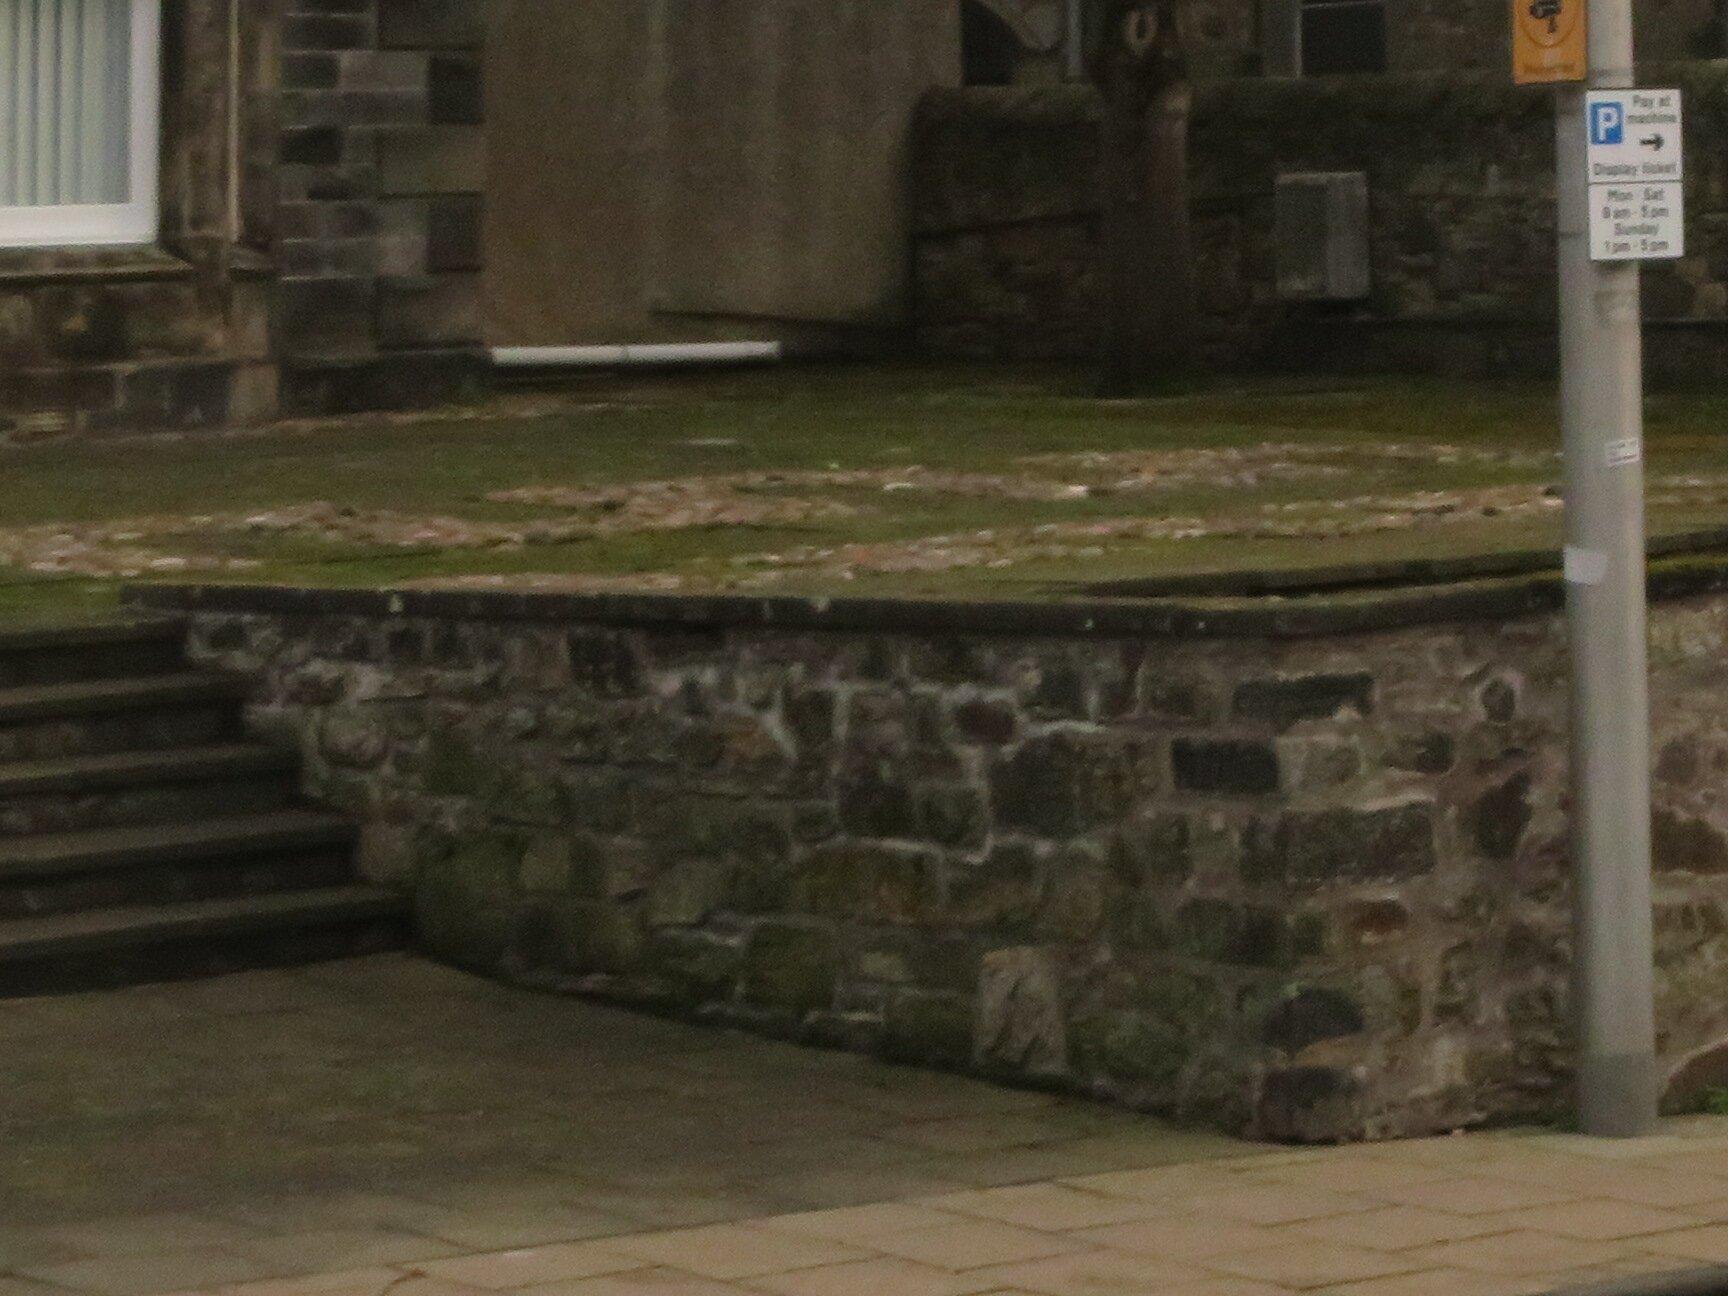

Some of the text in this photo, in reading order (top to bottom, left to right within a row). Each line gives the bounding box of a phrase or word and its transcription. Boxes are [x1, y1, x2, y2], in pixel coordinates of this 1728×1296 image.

[1632, 94, 1655, 109] Pay
[1598, 107, 1619, 141] P
[1593, 163, 1637, 177] Display
[1607, 187, 1664, 202] Mon Sat
[1614, 222, 1659, 237] Sunday
